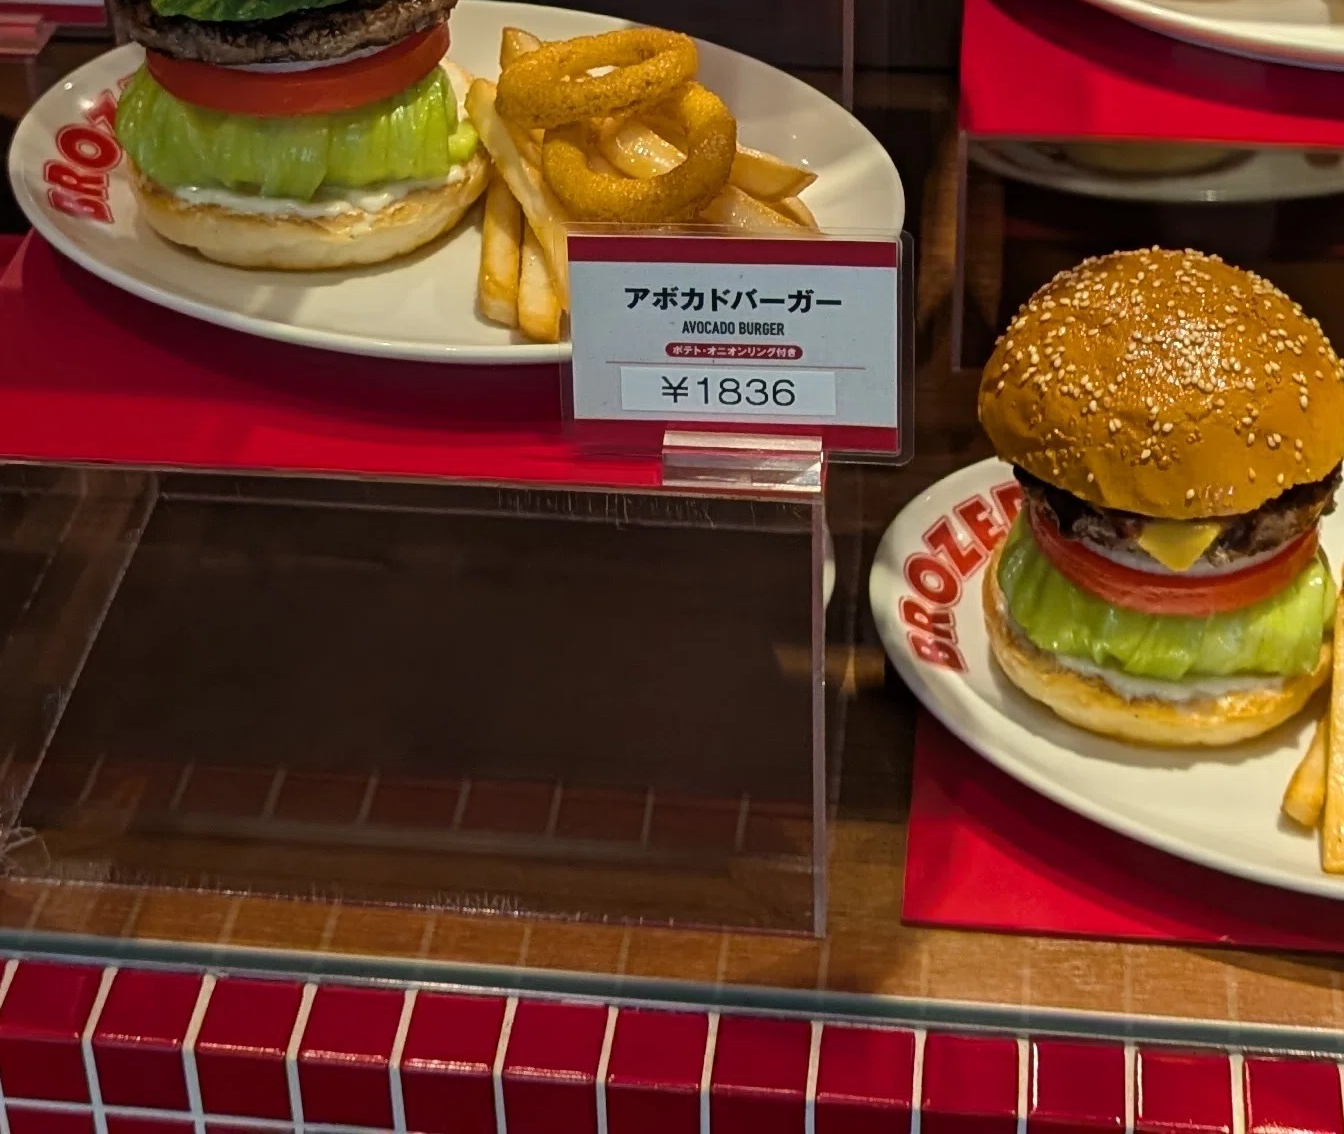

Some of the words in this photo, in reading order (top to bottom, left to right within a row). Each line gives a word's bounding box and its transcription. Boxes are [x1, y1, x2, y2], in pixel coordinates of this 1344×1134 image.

[624, 286, 843, 314] アボカドバーガー
[681, 320, 736, 336] AVOCADO
[738, 321, 785, 336] BURGER
[660, 375, 797, 407] ¥1836
